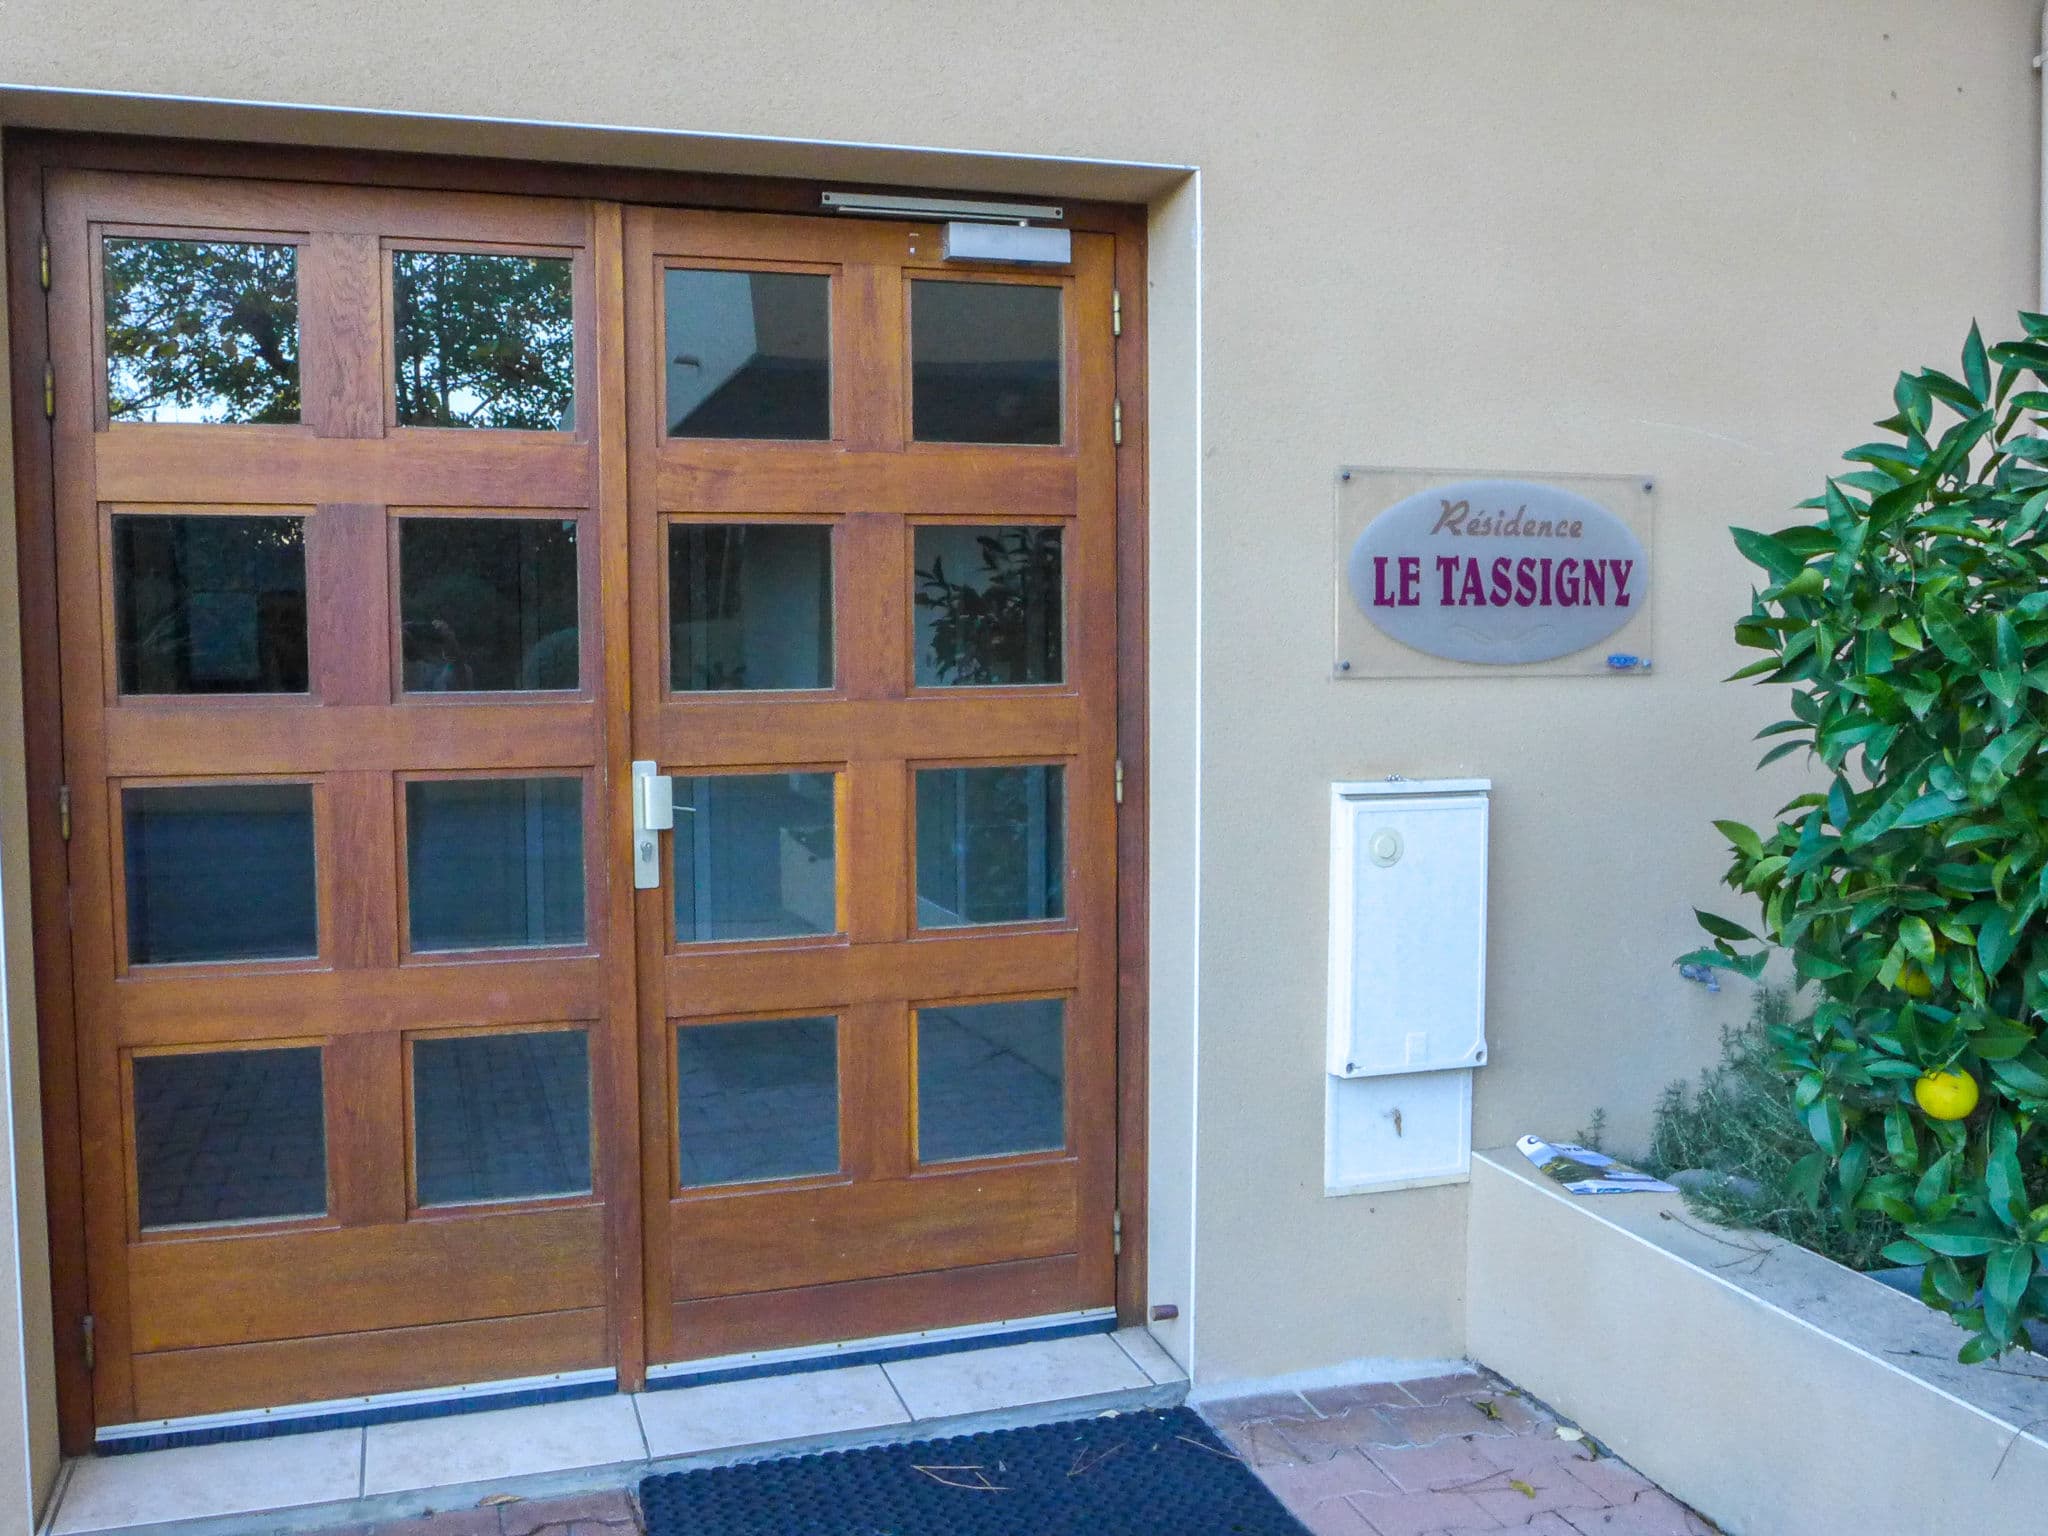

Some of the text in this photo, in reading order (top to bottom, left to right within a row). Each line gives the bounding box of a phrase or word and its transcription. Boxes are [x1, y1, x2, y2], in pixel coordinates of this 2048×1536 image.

[1429, 499, 1583, 538] Résidence
[1373, 555, 1633, 608] LE TASSIGNY
